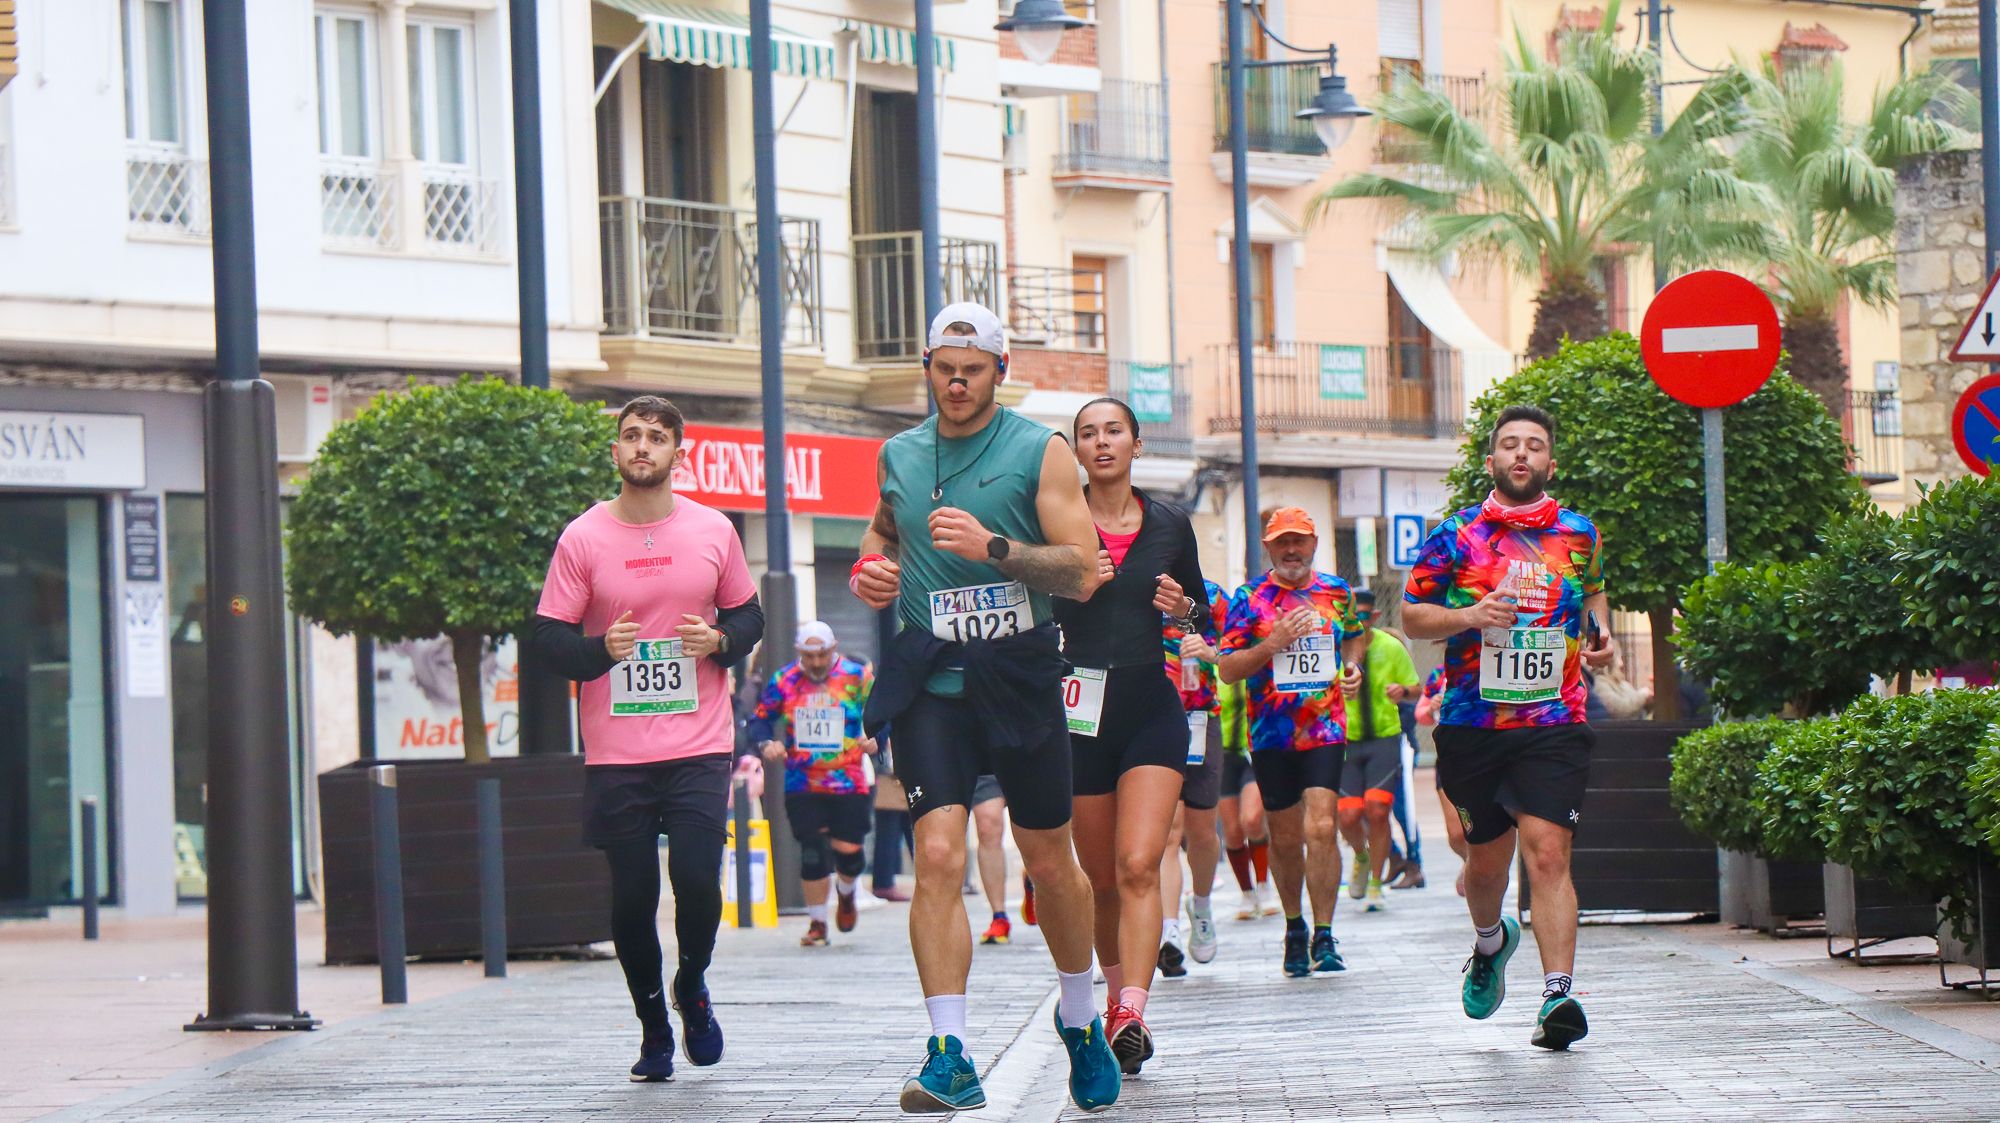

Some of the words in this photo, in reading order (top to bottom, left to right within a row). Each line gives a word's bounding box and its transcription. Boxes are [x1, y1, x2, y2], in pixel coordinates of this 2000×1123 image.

[0, 416, 86, 460] SVÁN
[696, 440, 823, 500] GENEALI
[1398, 518, 1420, 562] P
[625, 556, 672, 569] MOMENTUM
[944, 589, 978, 613] 21K
[947, 610, 1019, 642] 1023
[622, 661, 682, 692] 1353
[1286, 653, 1320, 674] 762
[1493, 650, 1553, 680] 1165
[806, 721, 830, 737] 141
